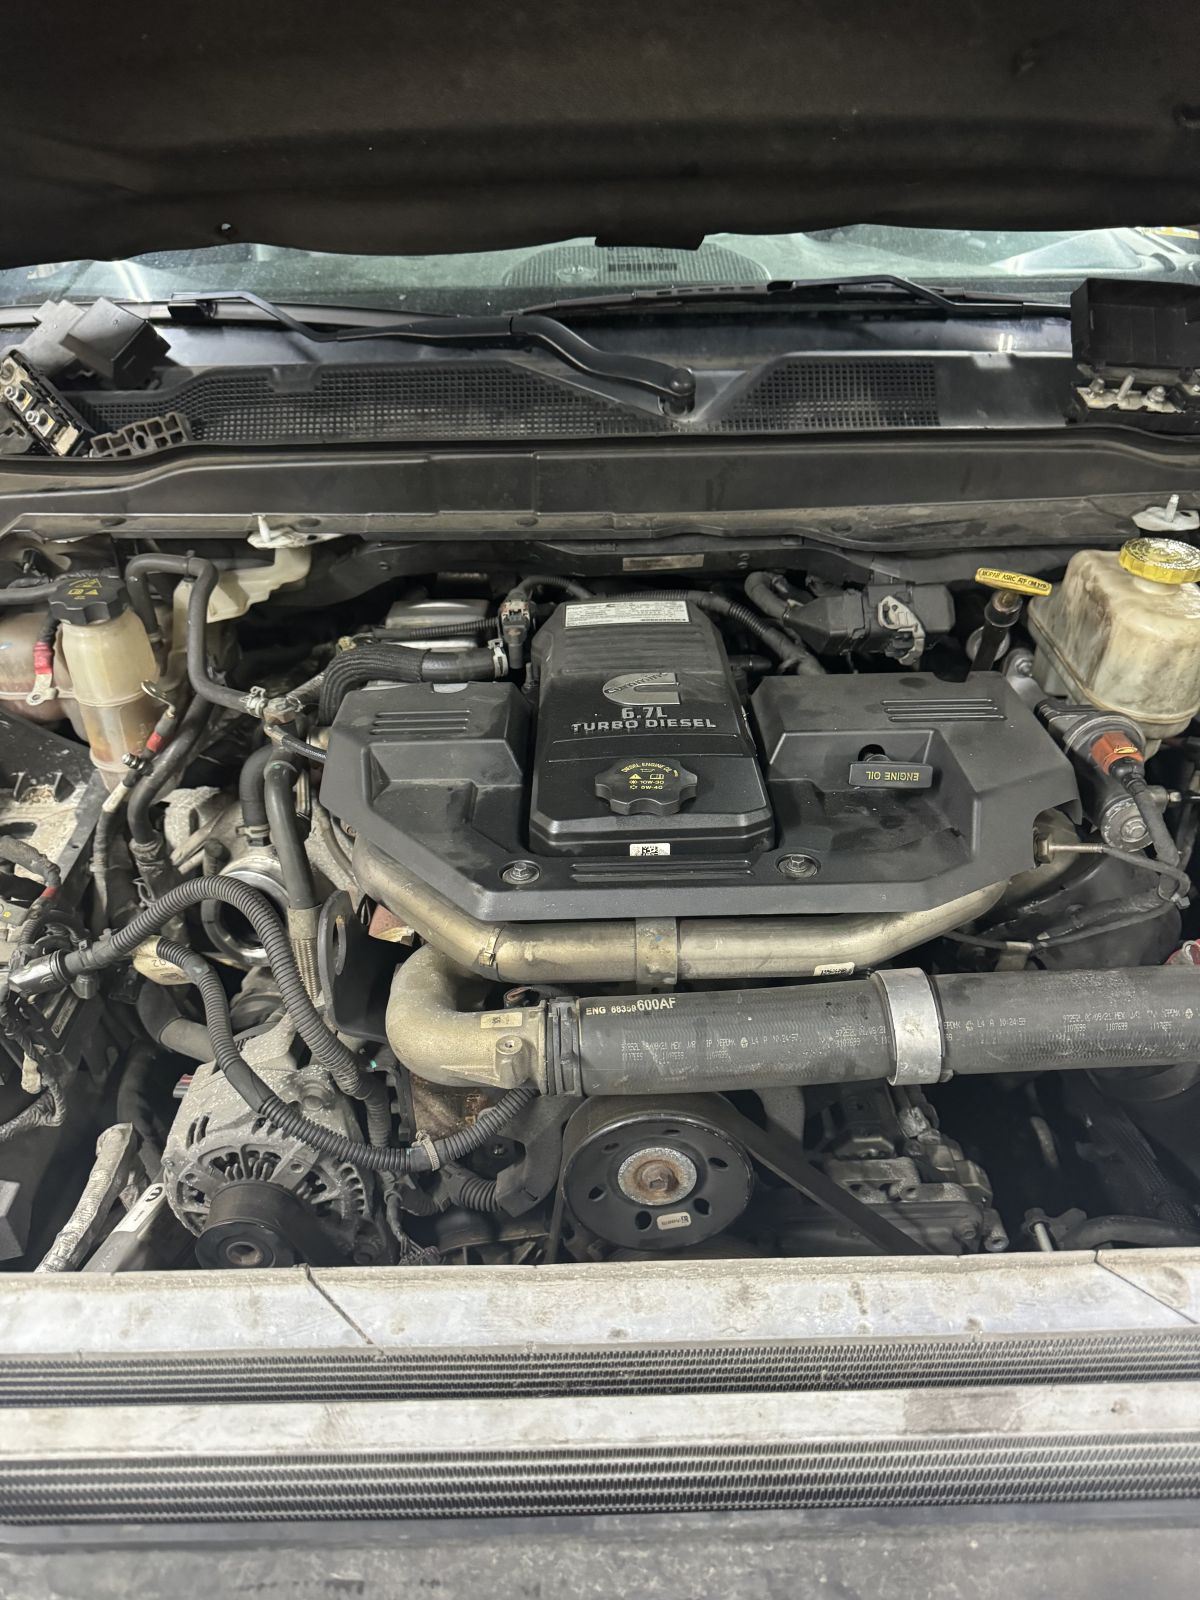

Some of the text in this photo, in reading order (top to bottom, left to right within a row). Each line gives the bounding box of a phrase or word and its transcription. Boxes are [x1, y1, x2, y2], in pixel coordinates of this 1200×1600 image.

[621, 706, 668, 719] 6.7L
[571, 718, 717, 733] TURBO DIESEL
[866, 771, 920, 782] ENGINE OIL
[585, 1006, 607, 1016] ENG
